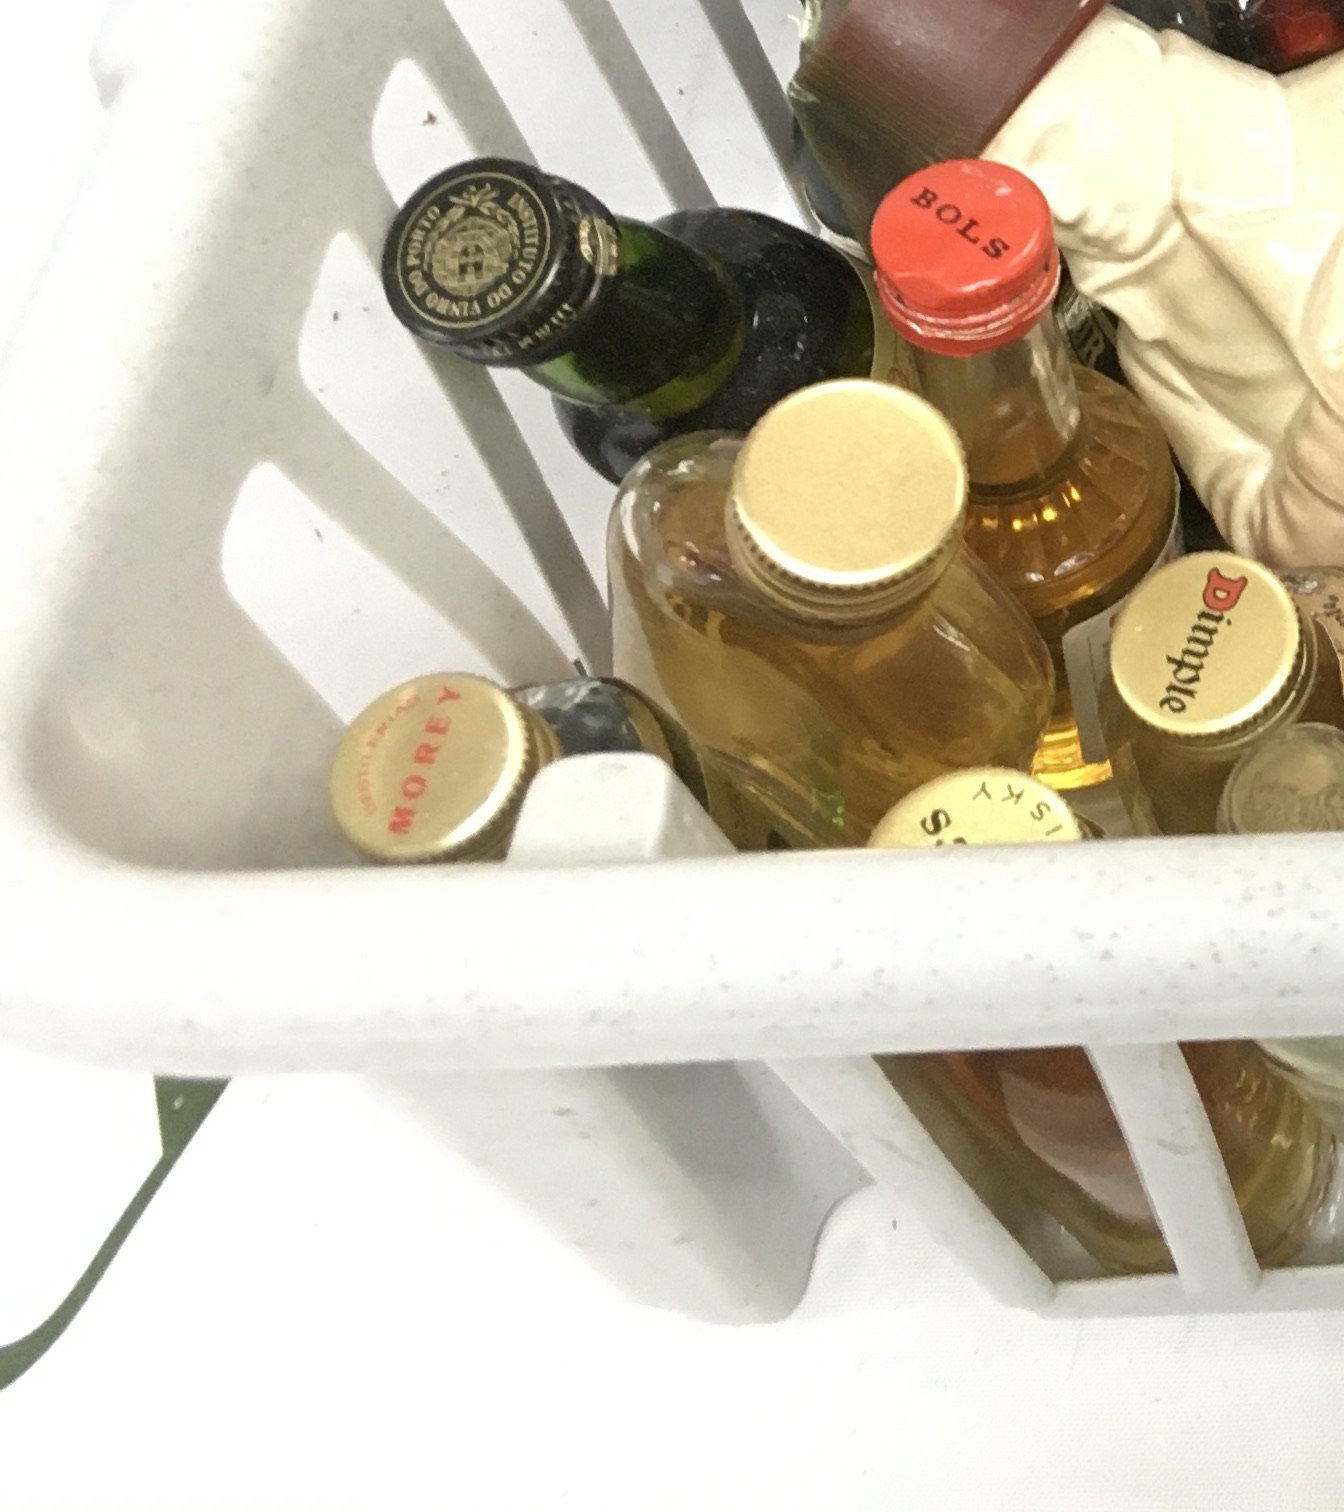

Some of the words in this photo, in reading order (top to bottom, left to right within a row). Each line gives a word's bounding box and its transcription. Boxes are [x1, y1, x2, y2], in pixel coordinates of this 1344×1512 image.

[406, 205, 441, 266] PORTO
[909, 186, 1011, 260] BOLS
[424, 292, 482, 317] VINHO
[486, 283, 513, 308] DO
[1159, 567, 1249, 714] Dimple
[387, 684, 461, 835] MOREY
[972, 780, 1063, 837] ISKY
